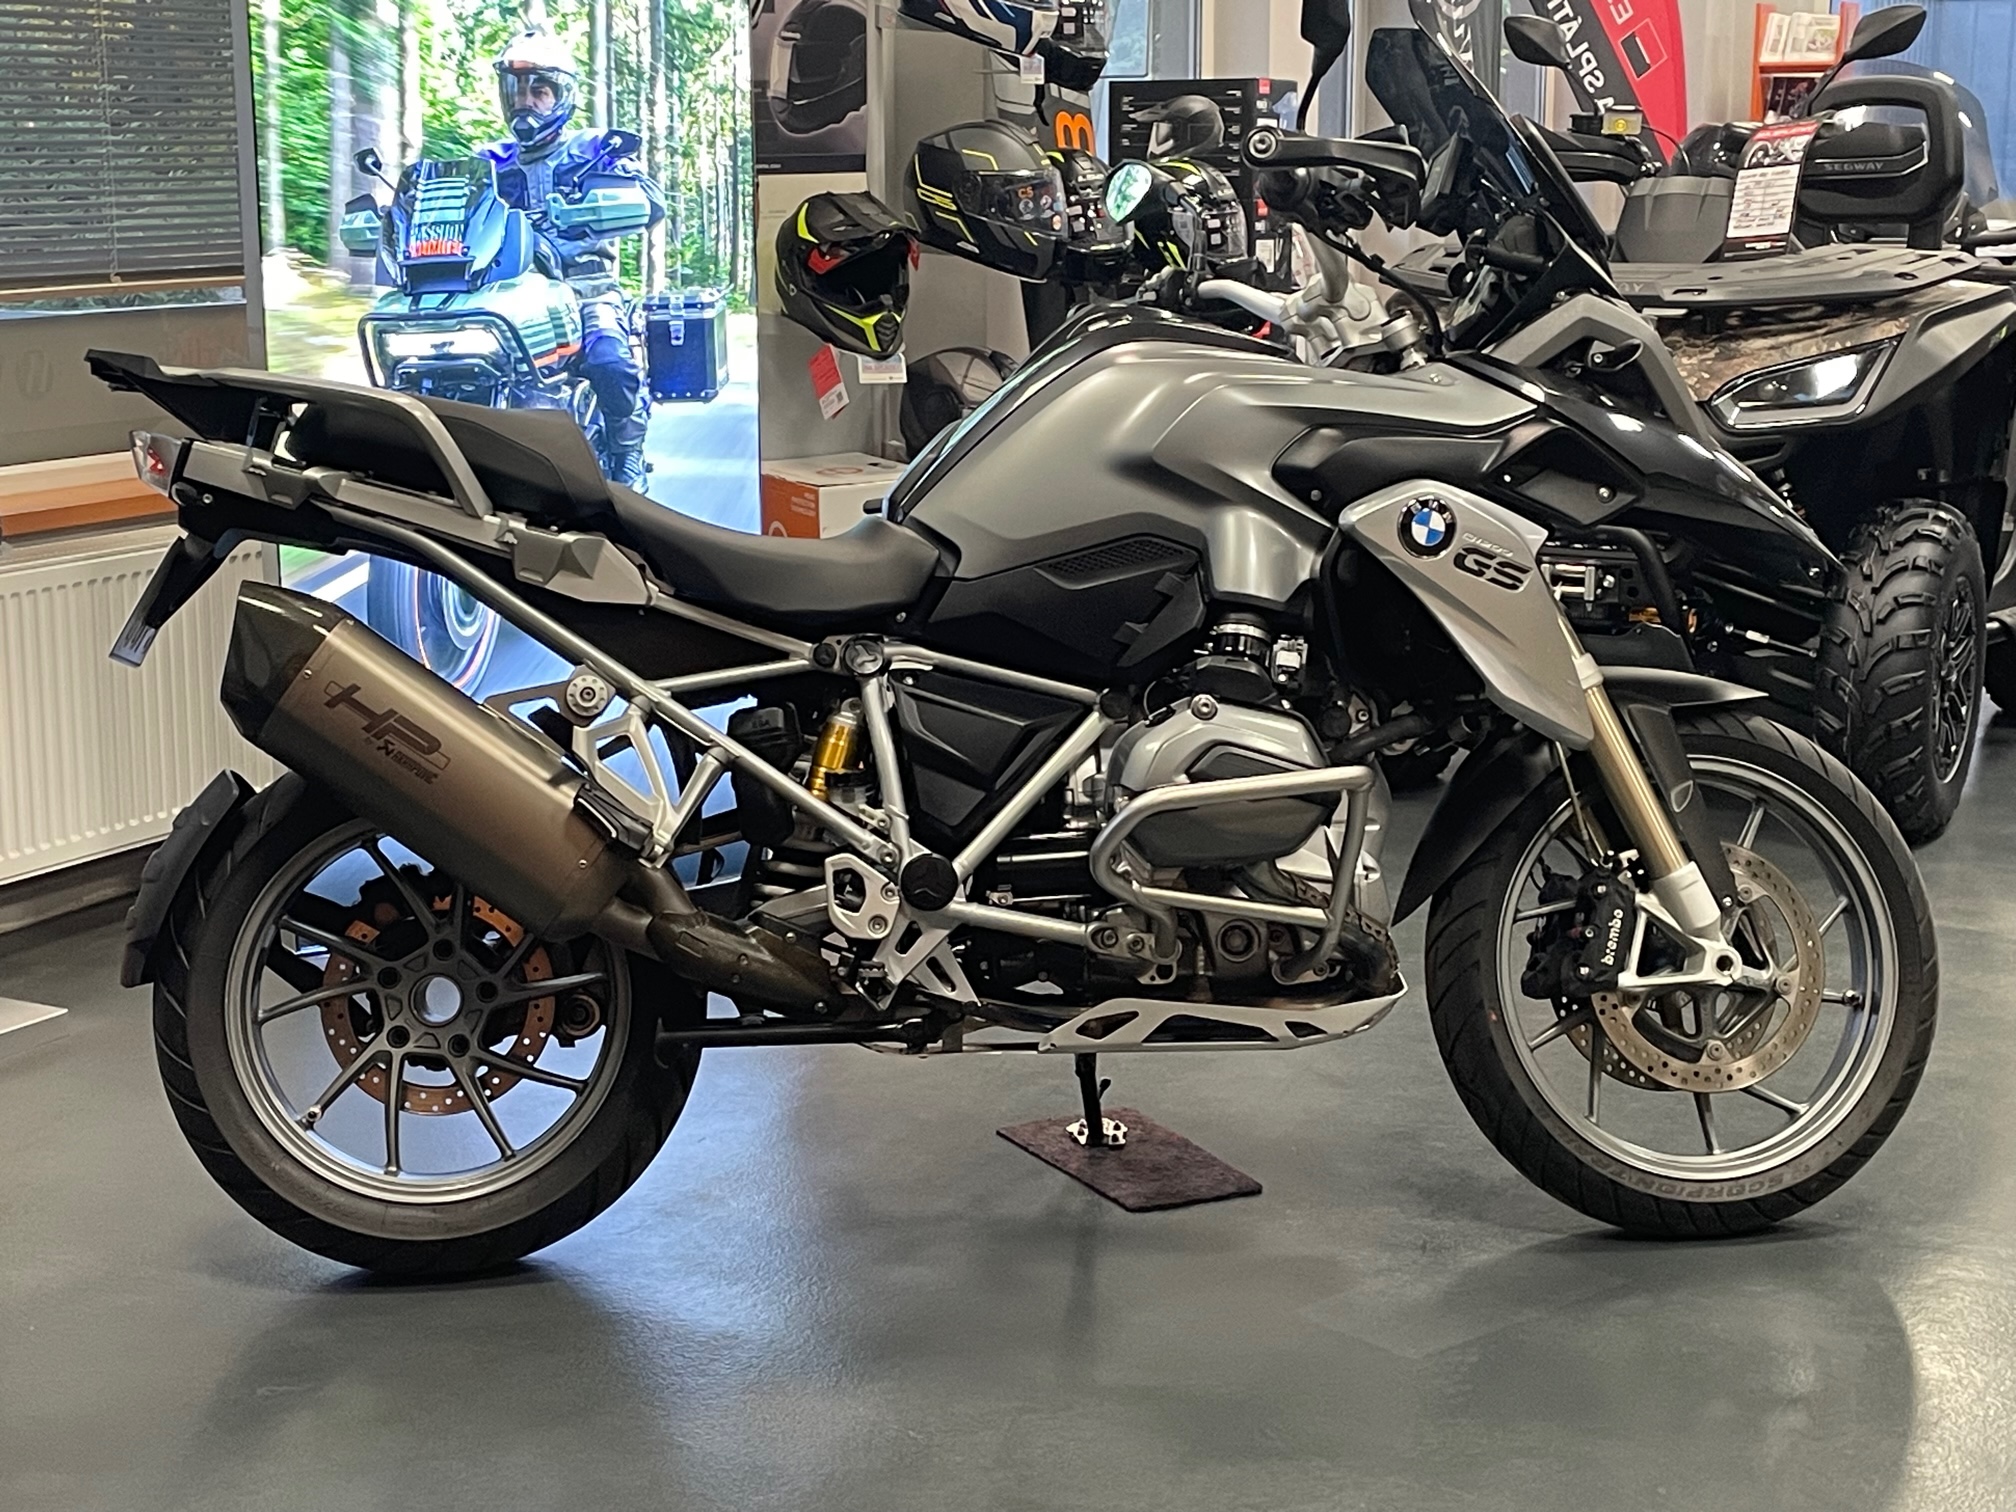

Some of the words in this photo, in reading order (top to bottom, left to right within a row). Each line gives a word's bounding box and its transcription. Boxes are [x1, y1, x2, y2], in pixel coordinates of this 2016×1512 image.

[1823, 161, 1885, 172] SEGWAY
[1453, 547, 1533, 591] GS
[324, 683, 442, 756] HP
[1601, 908, 1624, 967] brembo
